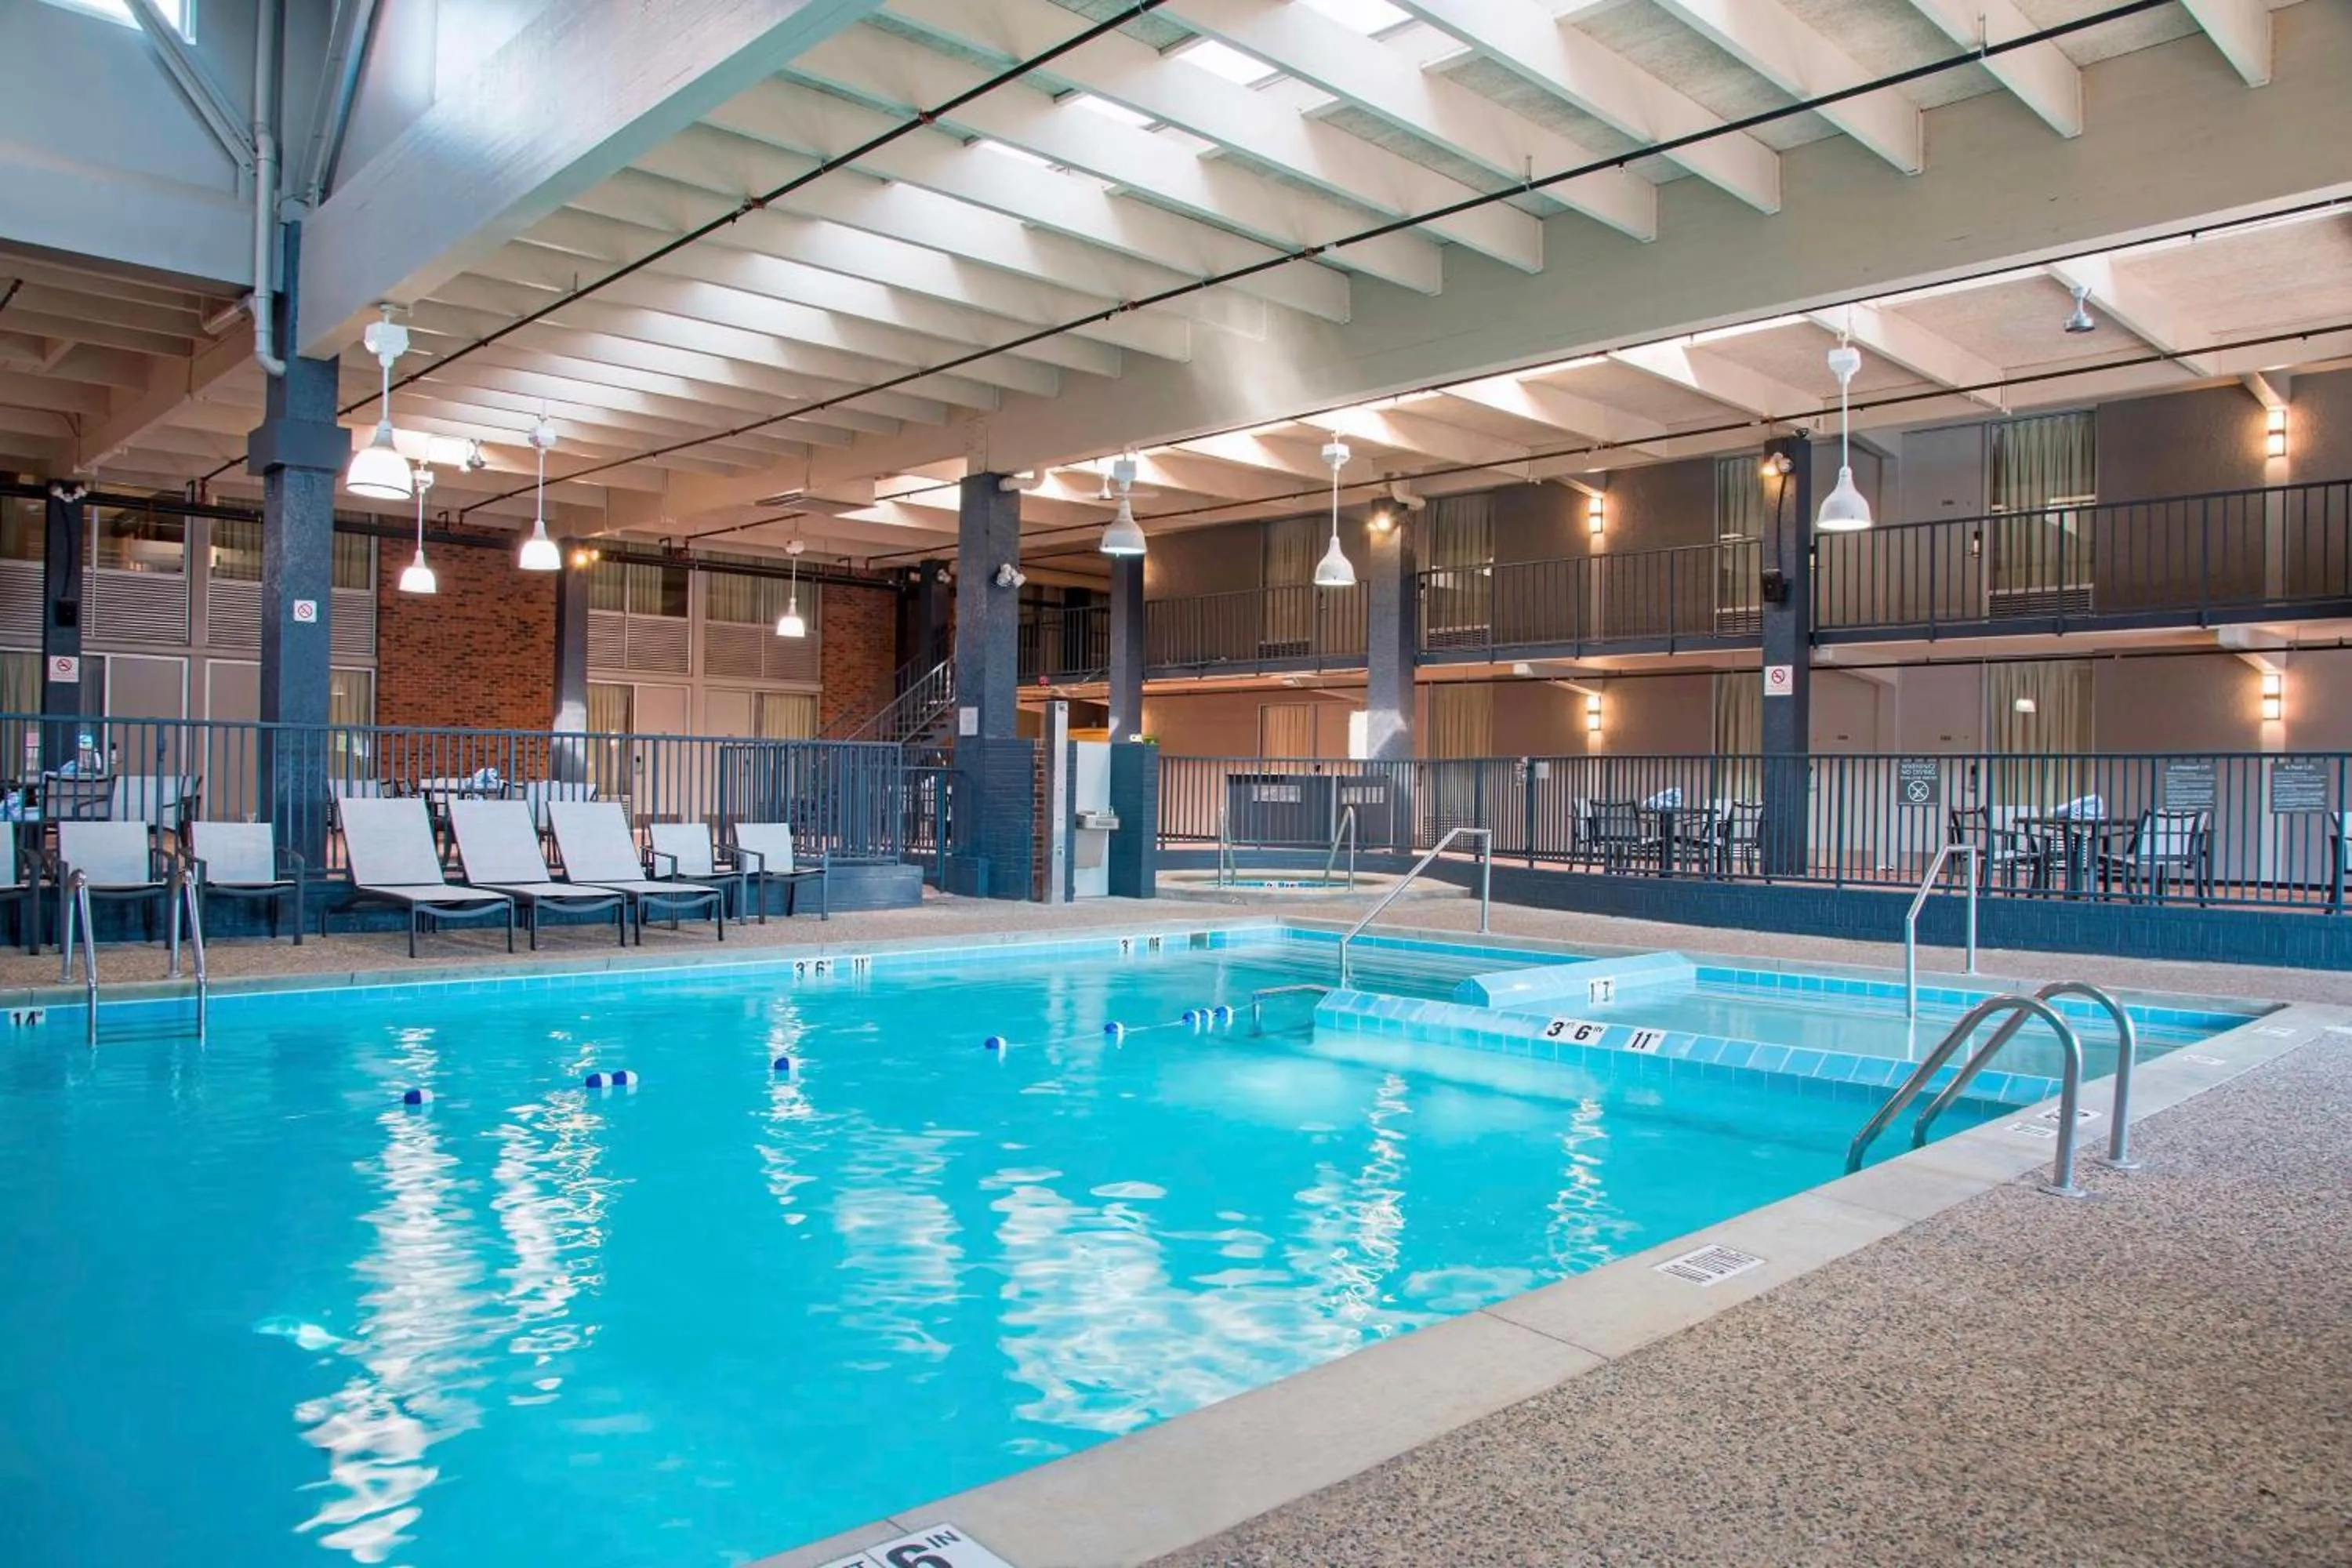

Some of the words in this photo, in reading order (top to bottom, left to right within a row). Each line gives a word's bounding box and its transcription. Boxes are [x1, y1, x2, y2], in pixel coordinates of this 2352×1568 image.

[1547, 1022, 1565, 1036] 3
[1574, 1025, 1592, 1040] 6
[925, 1530, 961, 1548] IN
